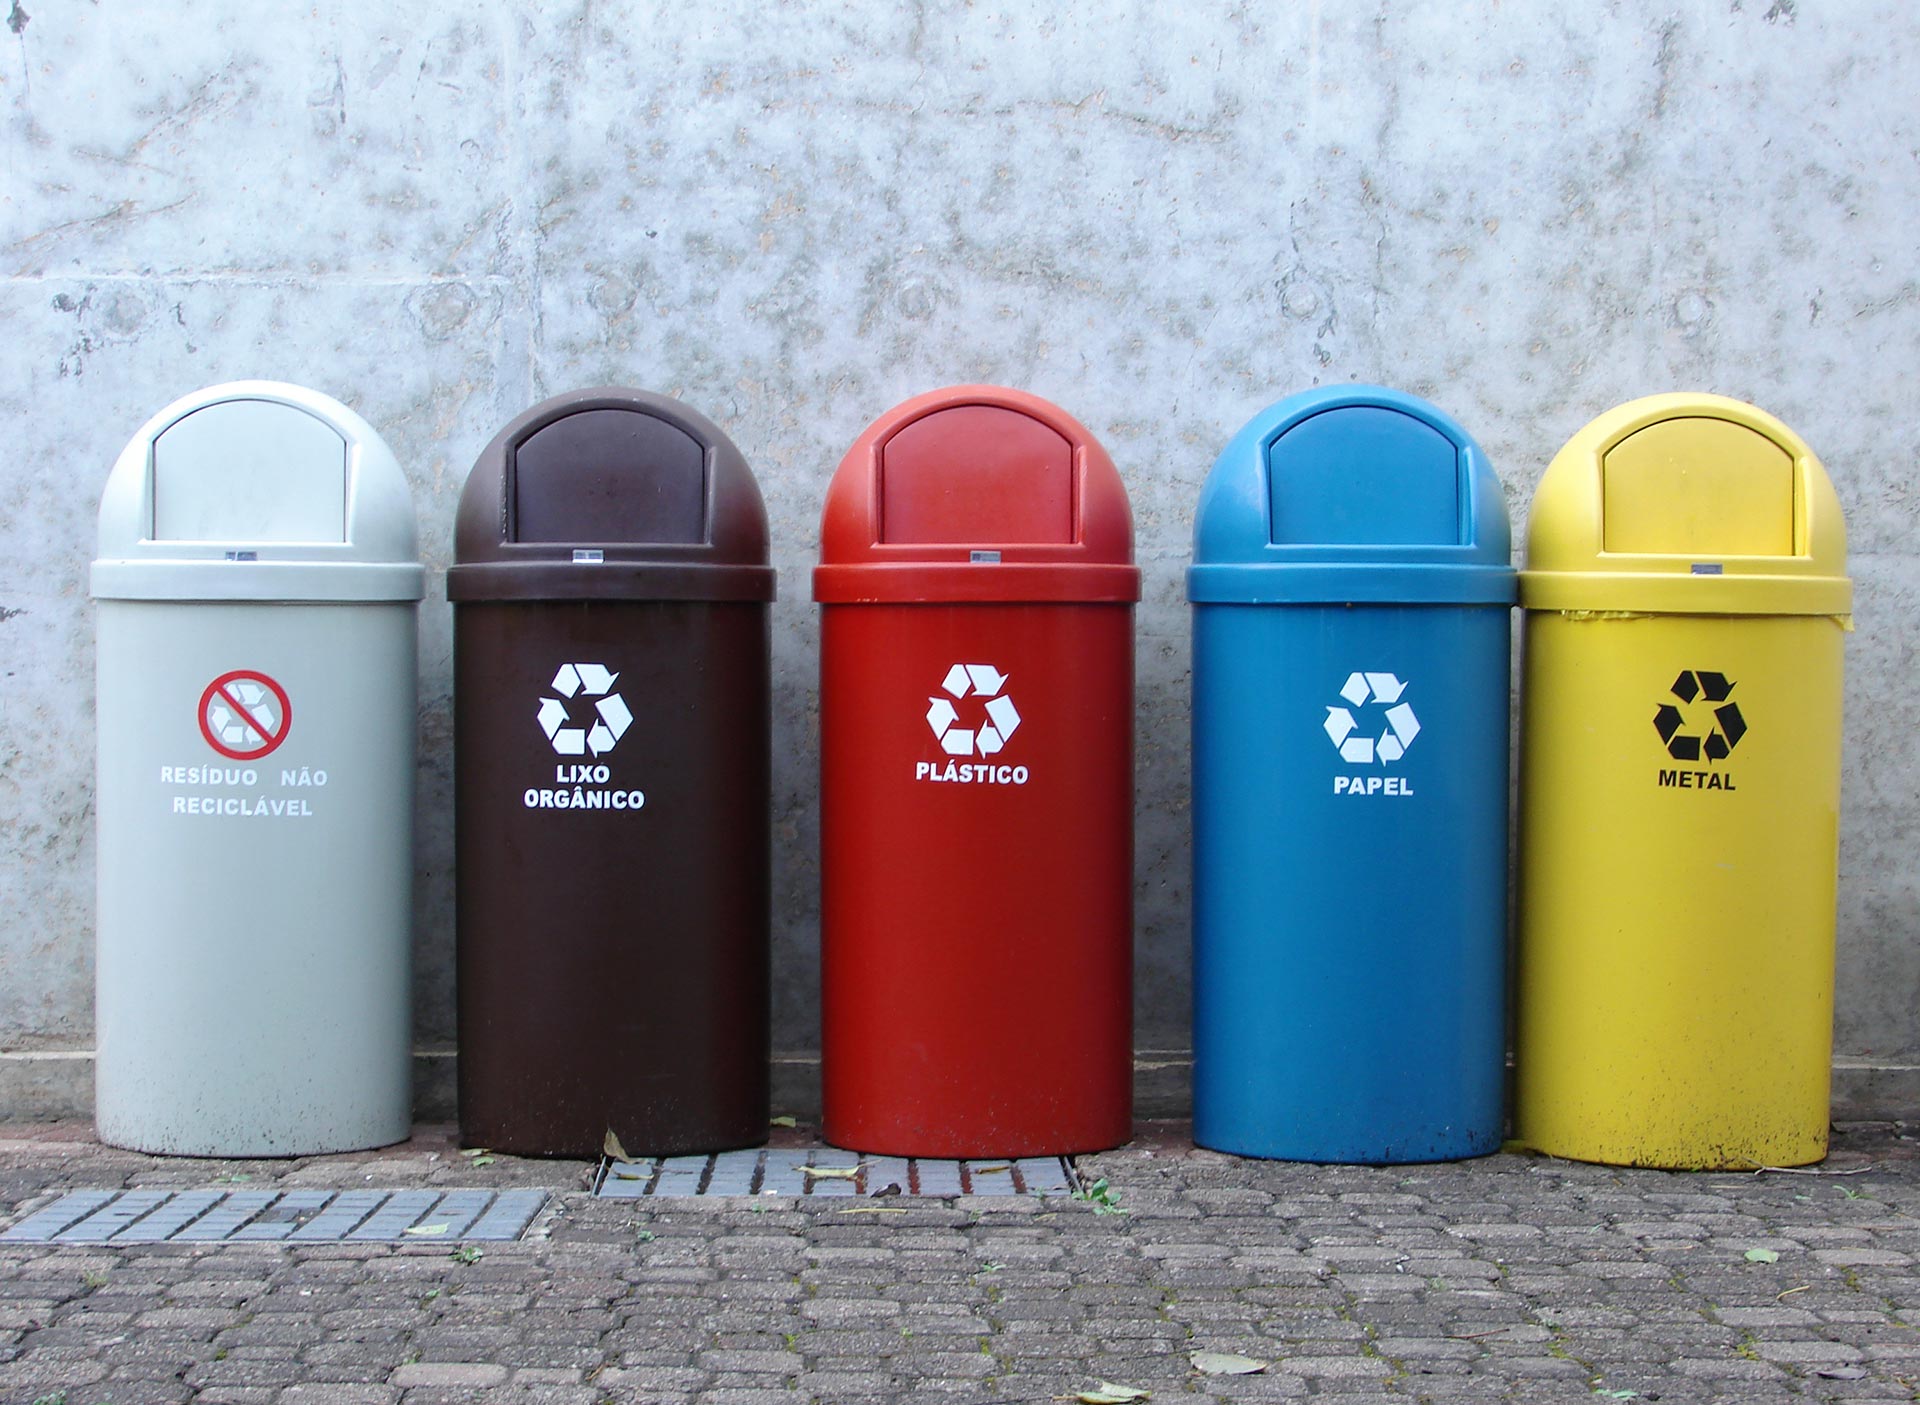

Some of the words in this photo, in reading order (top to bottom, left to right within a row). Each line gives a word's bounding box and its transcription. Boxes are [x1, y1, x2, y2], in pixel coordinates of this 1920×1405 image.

[161, 764, 258, 786] RESÍDUO
[281, 766, 328, 787] NÃO
[556, 764, 611, 784] LIXO
[916, 759, 1029, 785] PLÁSTICO
[1658, 769, 1737, 791] METAL
[1333, 776, 1414, 796] PAPEL
[173, 795, 313, 817] RECICLÁVEL
[524, 786, 645, 810] ORGÂNICO
